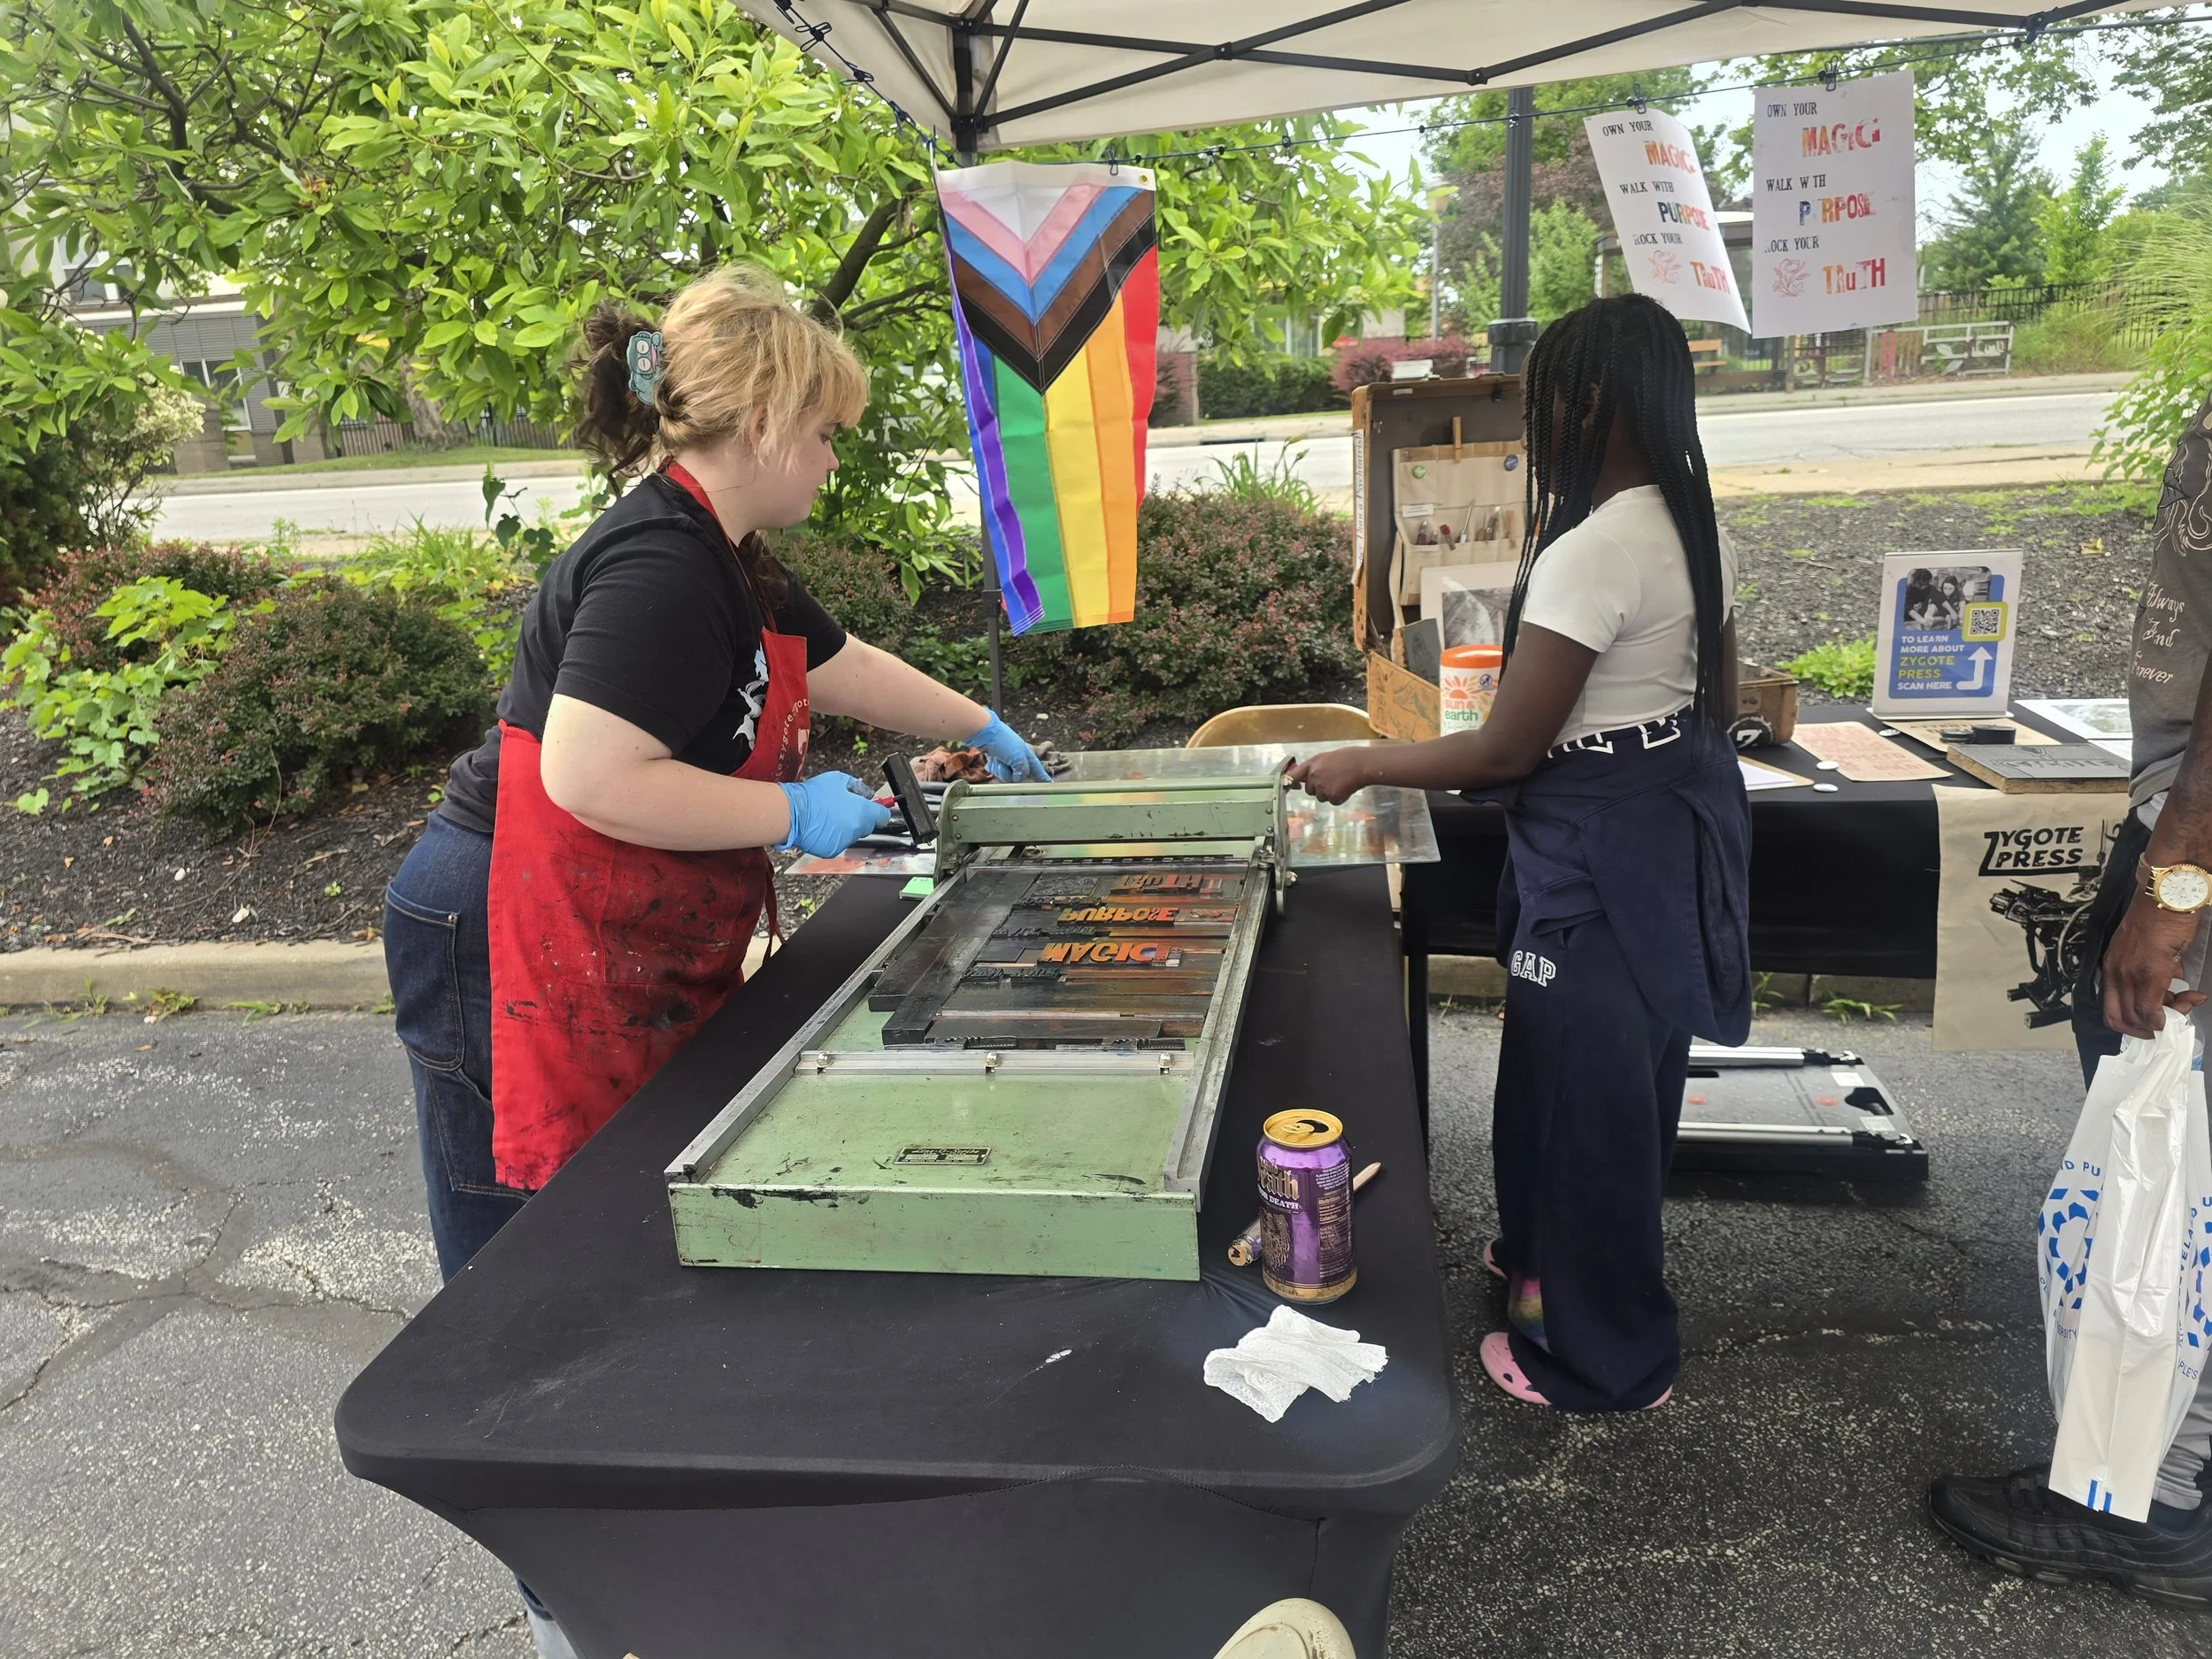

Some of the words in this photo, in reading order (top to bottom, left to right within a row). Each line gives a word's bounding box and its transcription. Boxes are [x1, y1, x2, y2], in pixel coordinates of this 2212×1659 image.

[1767, 104, 1786, 118] OWN
[1793, 102, 1817, 116] YOUR
[1602, 123, 1624, 136] OWN
[1629, 120, 1654, 132] YOUR
[1619, 182, 1648, 195] WALK
[1652, 180, 1674, 193] WITH
[1766, 178, 1793, 192] WALK
[1800, 174, 1826, 189] WTH
[1799, 191, 1876, 226] PRPOSE
[1632, 234, 1658, 245] ROCK
[1661, 233, 1683, 245] YOUR
[1764, 239, 1788, 253] OCK
[1794, 236, 1819, 250] YOUR
[2147, 580, 2185, 622] Always
[1916, 634, 1948, 643] LEARN
[2142, 618, 2180, 647] And
[1931, 644, 1965, 653] ABOUT
[1900, 656, 1955, 666] ZYGOTE
[1897, 669, 1941, 680] PRESS
[1897, 681, 1924, 690] SCAN
[1925, 680, 1952, 690] HERE
[1445, 700, 1465, 710] sun
[1445, 710, 1479, 721] earth
[1978, 826, 2085, 871] ZYGOTE
[1995, 849, 2084, 868] PRESS
[1510, 949, 1557, 987] GAP
[1269, 1195, 1299, 1210] DEATH
